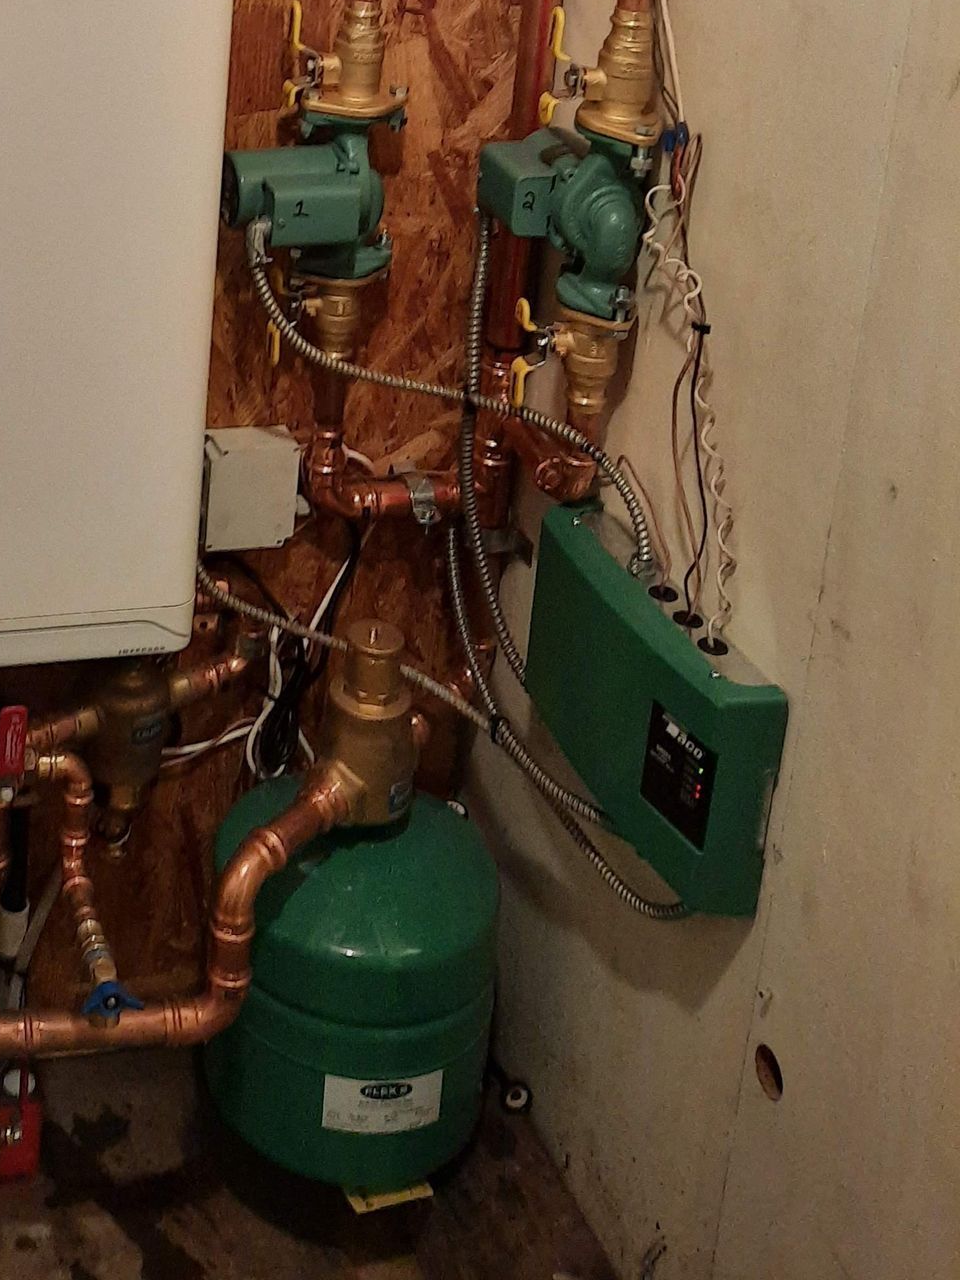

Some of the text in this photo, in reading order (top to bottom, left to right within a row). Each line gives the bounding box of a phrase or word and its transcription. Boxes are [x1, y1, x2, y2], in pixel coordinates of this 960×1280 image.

[293, 199, 309, 217] 1
[522, 190, 535, 211] 2
[663, 715, 704, 760] Taco
